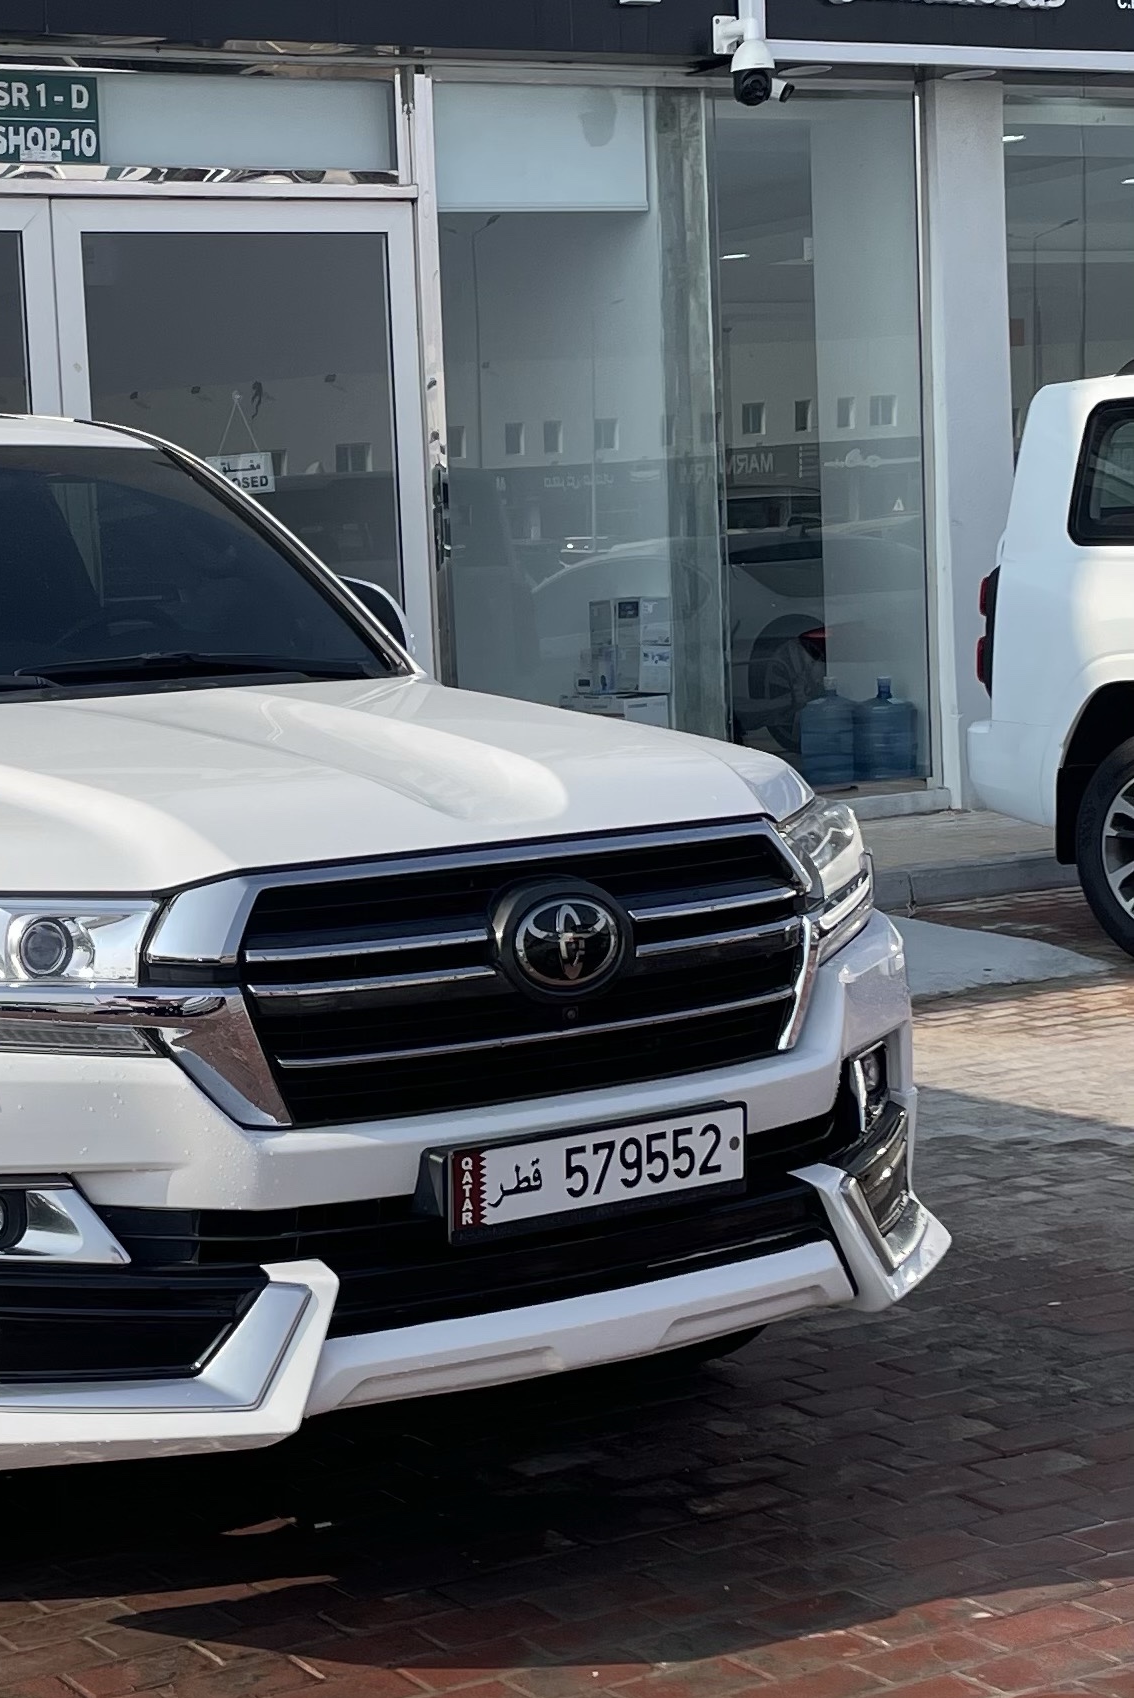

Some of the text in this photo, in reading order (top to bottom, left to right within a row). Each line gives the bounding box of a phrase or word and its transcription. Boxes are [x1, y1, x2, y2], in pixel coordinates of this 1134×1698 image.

[35, 83, 46, 107] 1
[70, 84, 89, 109] D
[231, 476, 268, 488] OSED
[487, 1158, 543, 1208] قطر
[565, 1123, 722, 1198] 579552
[461, 1157, 473, 1225] QATAR
